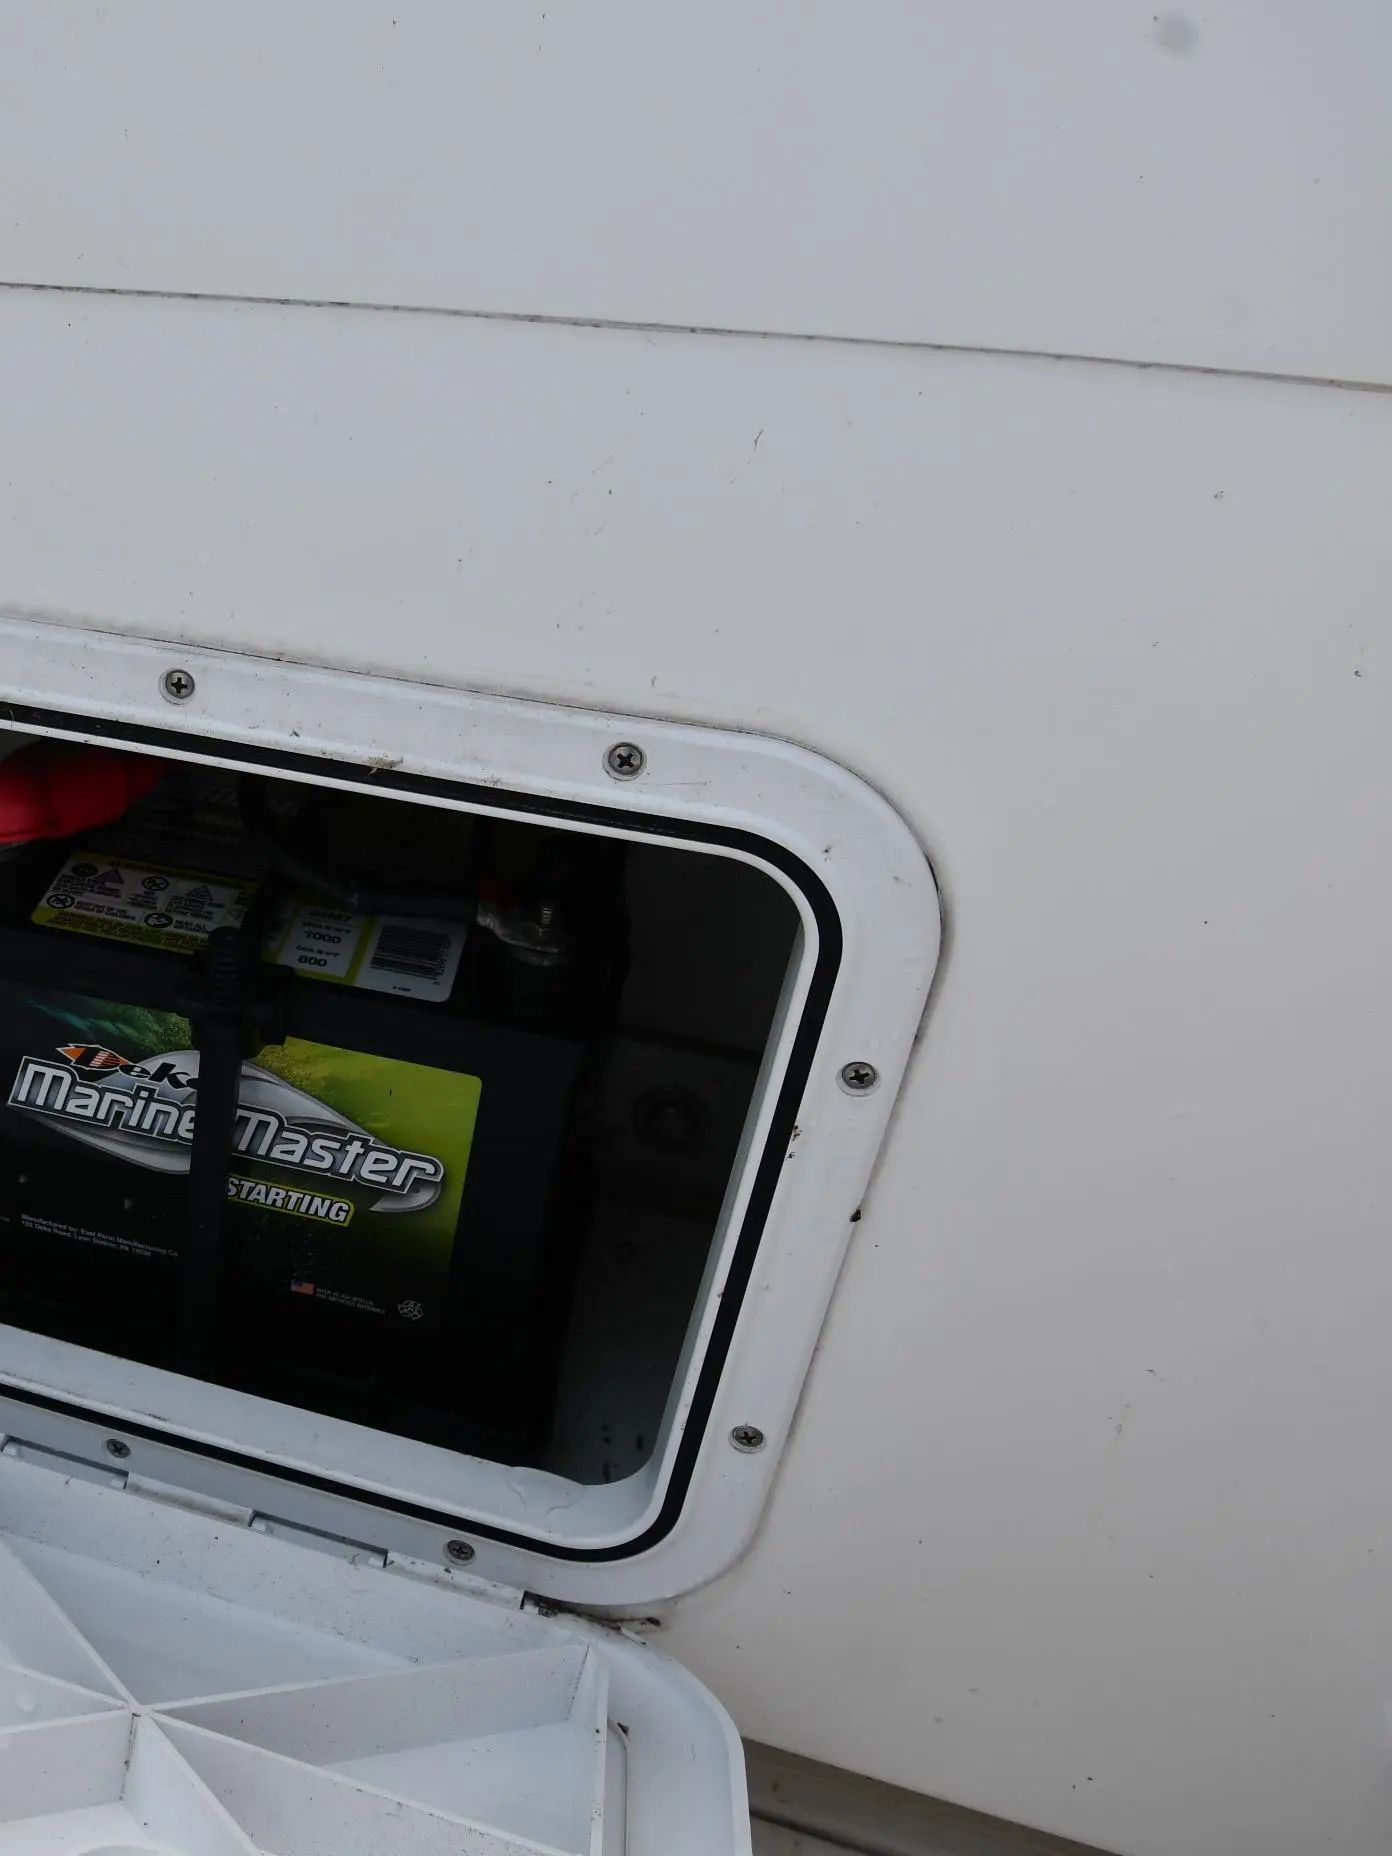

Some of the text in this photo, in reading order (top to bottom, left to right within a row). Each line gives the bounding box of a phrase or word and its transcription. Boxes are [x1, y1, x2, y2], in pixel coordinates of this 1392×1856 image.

[304, 930, 342, 945] 1000
[10, 1058, 442, 1191] Marine Master
[227, 1177, 350, 1222] STARTING
